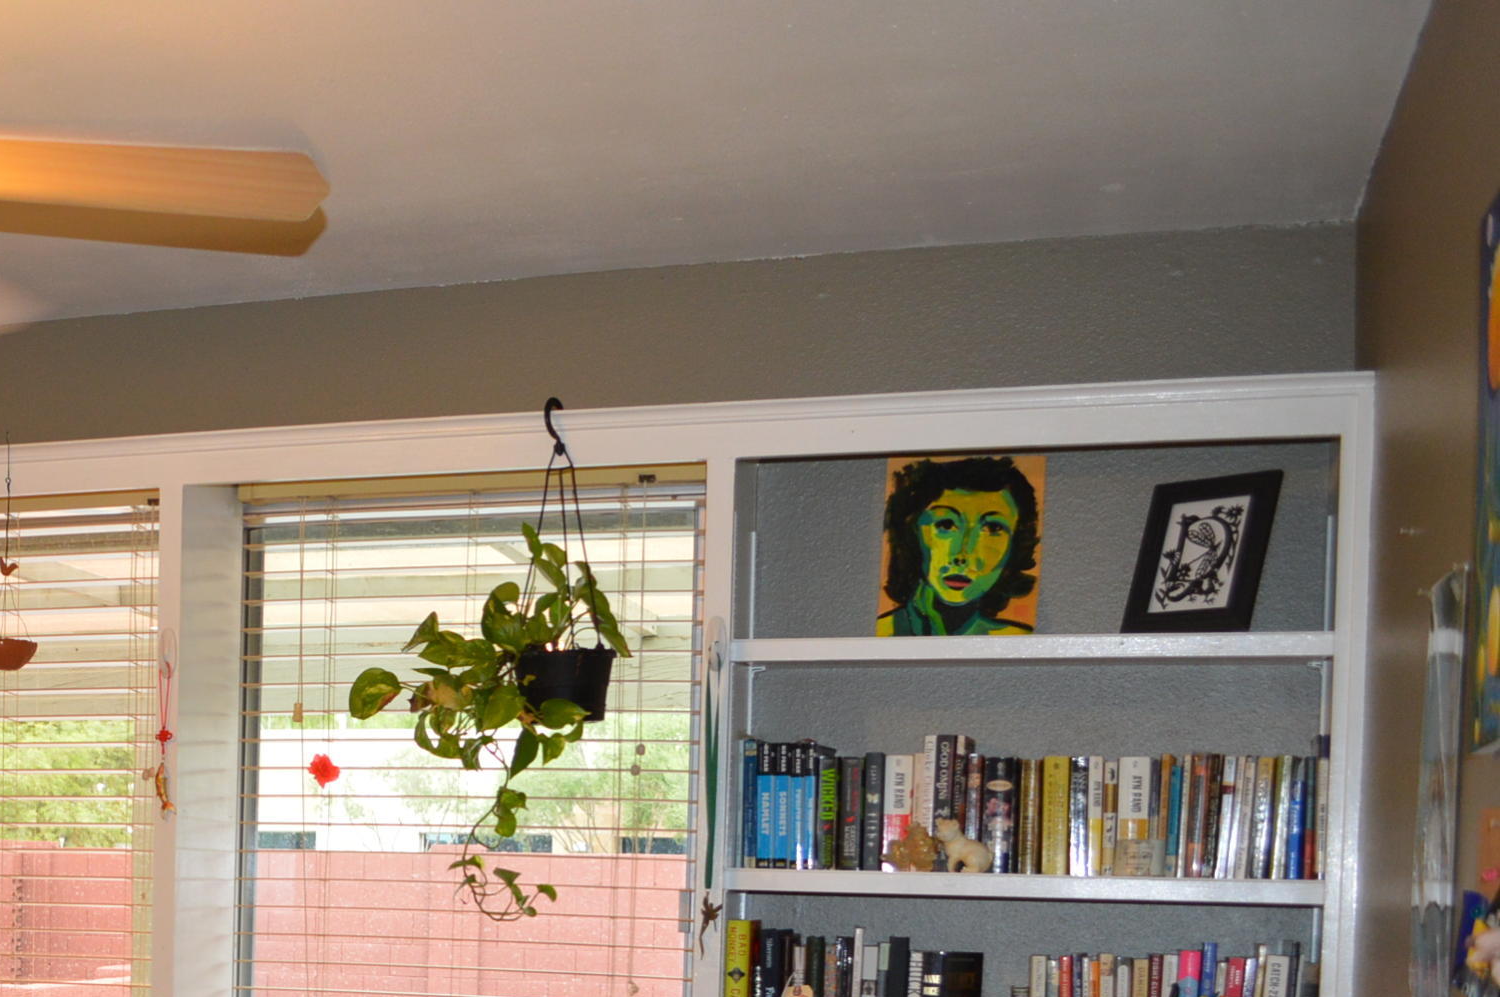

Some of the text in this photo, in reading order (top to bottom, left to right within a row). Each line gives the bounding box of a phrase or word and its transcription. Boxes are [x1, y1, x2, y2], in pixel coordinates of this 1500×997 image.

[936, 741, 949, 800] GOOD OMENS
[820, 768, 836, 820] WICKED
[894, 772, 905, 809] AYN RAND
[1131, 775, 1143, 812] AYN RAND
[761, 792, 770, 836] HAMLET
[728, 927, 737, 962] MONKEY
[738, 934, 747, 956] BAD
[924, 974, 941, 984] ANNE
